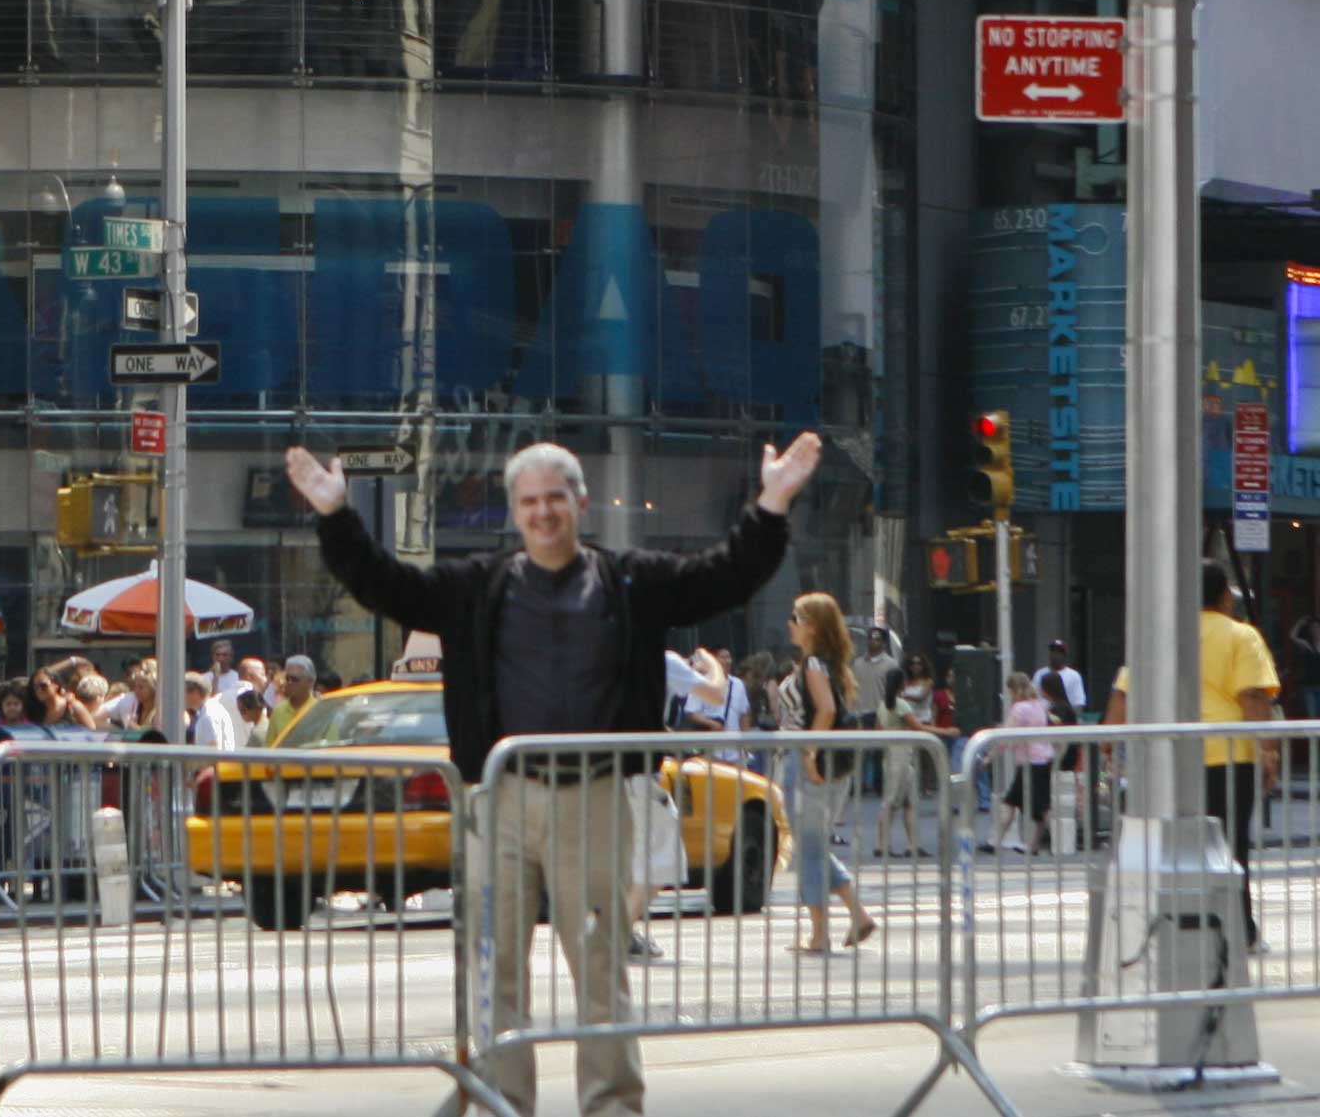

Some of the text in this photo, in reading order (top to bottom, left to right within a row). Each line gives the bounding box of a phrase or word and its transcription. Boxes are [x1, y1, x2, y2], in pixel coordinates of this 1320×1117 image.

[989, 27, 1117, 49] NO STOPPING
[1004, 56, 1102, 78] ANYTIME
[105, 222, 138, 246] TIMES
[74, 252, 89, 276] W
[98, 251, 123, 275] 43
[1010, 306, 1048, 326] 67.2
[126, 355, 206, 372] ONE WAY
[1047, 203, 1080, 512] MARKETSITE
[347, 453, 406, 468] ONE WAY
